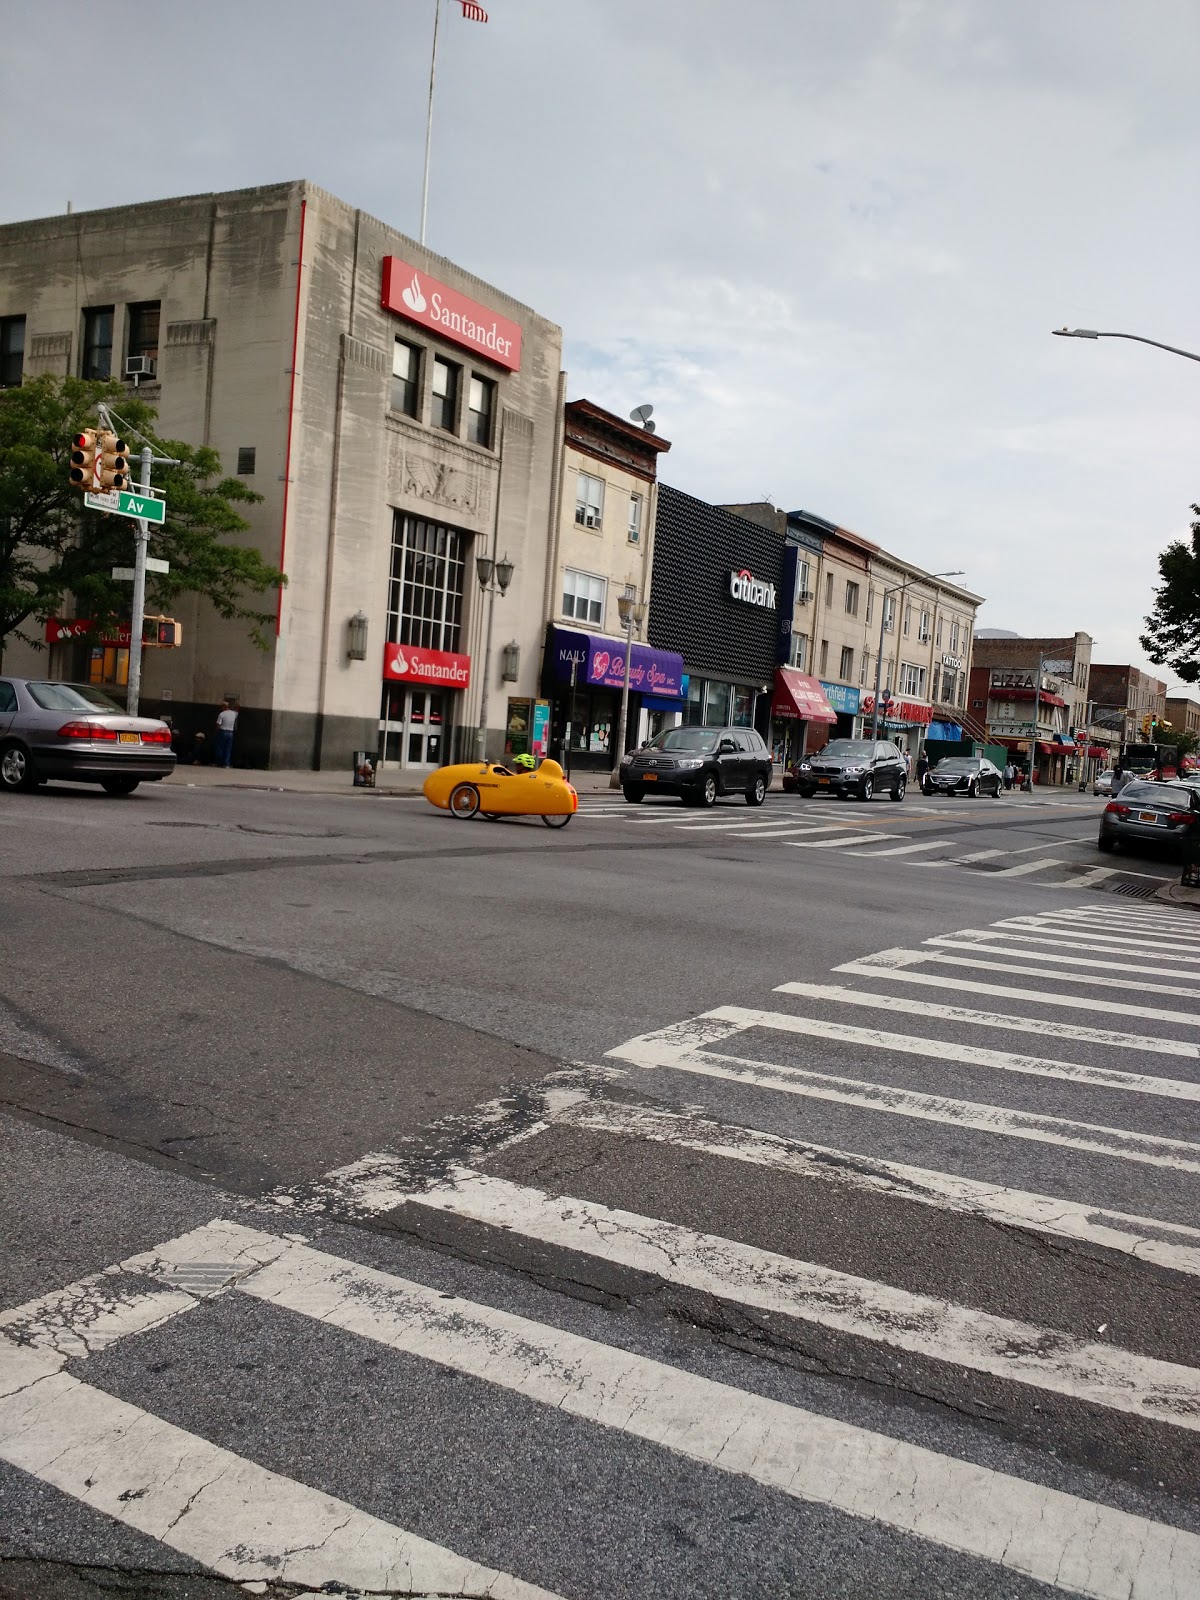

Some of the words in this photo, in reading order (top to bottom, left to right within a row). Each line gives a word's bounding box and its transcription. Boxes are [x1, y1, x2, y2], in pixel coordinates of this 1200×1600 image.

[430, 292, 512, 358] Santander
[127, 498, 145, 514] Av
[731, 574, 777, 610] citibank
[559, 648, 586, 663] NAILS
[942, 655, 962, 669] TATTOO
[410, 656, 468, 682] Santander
[609, 656, 645, 686] Beuty
[646, 663, 667, 687] Spa
[991, 674, 1036, 688] PIZZA
